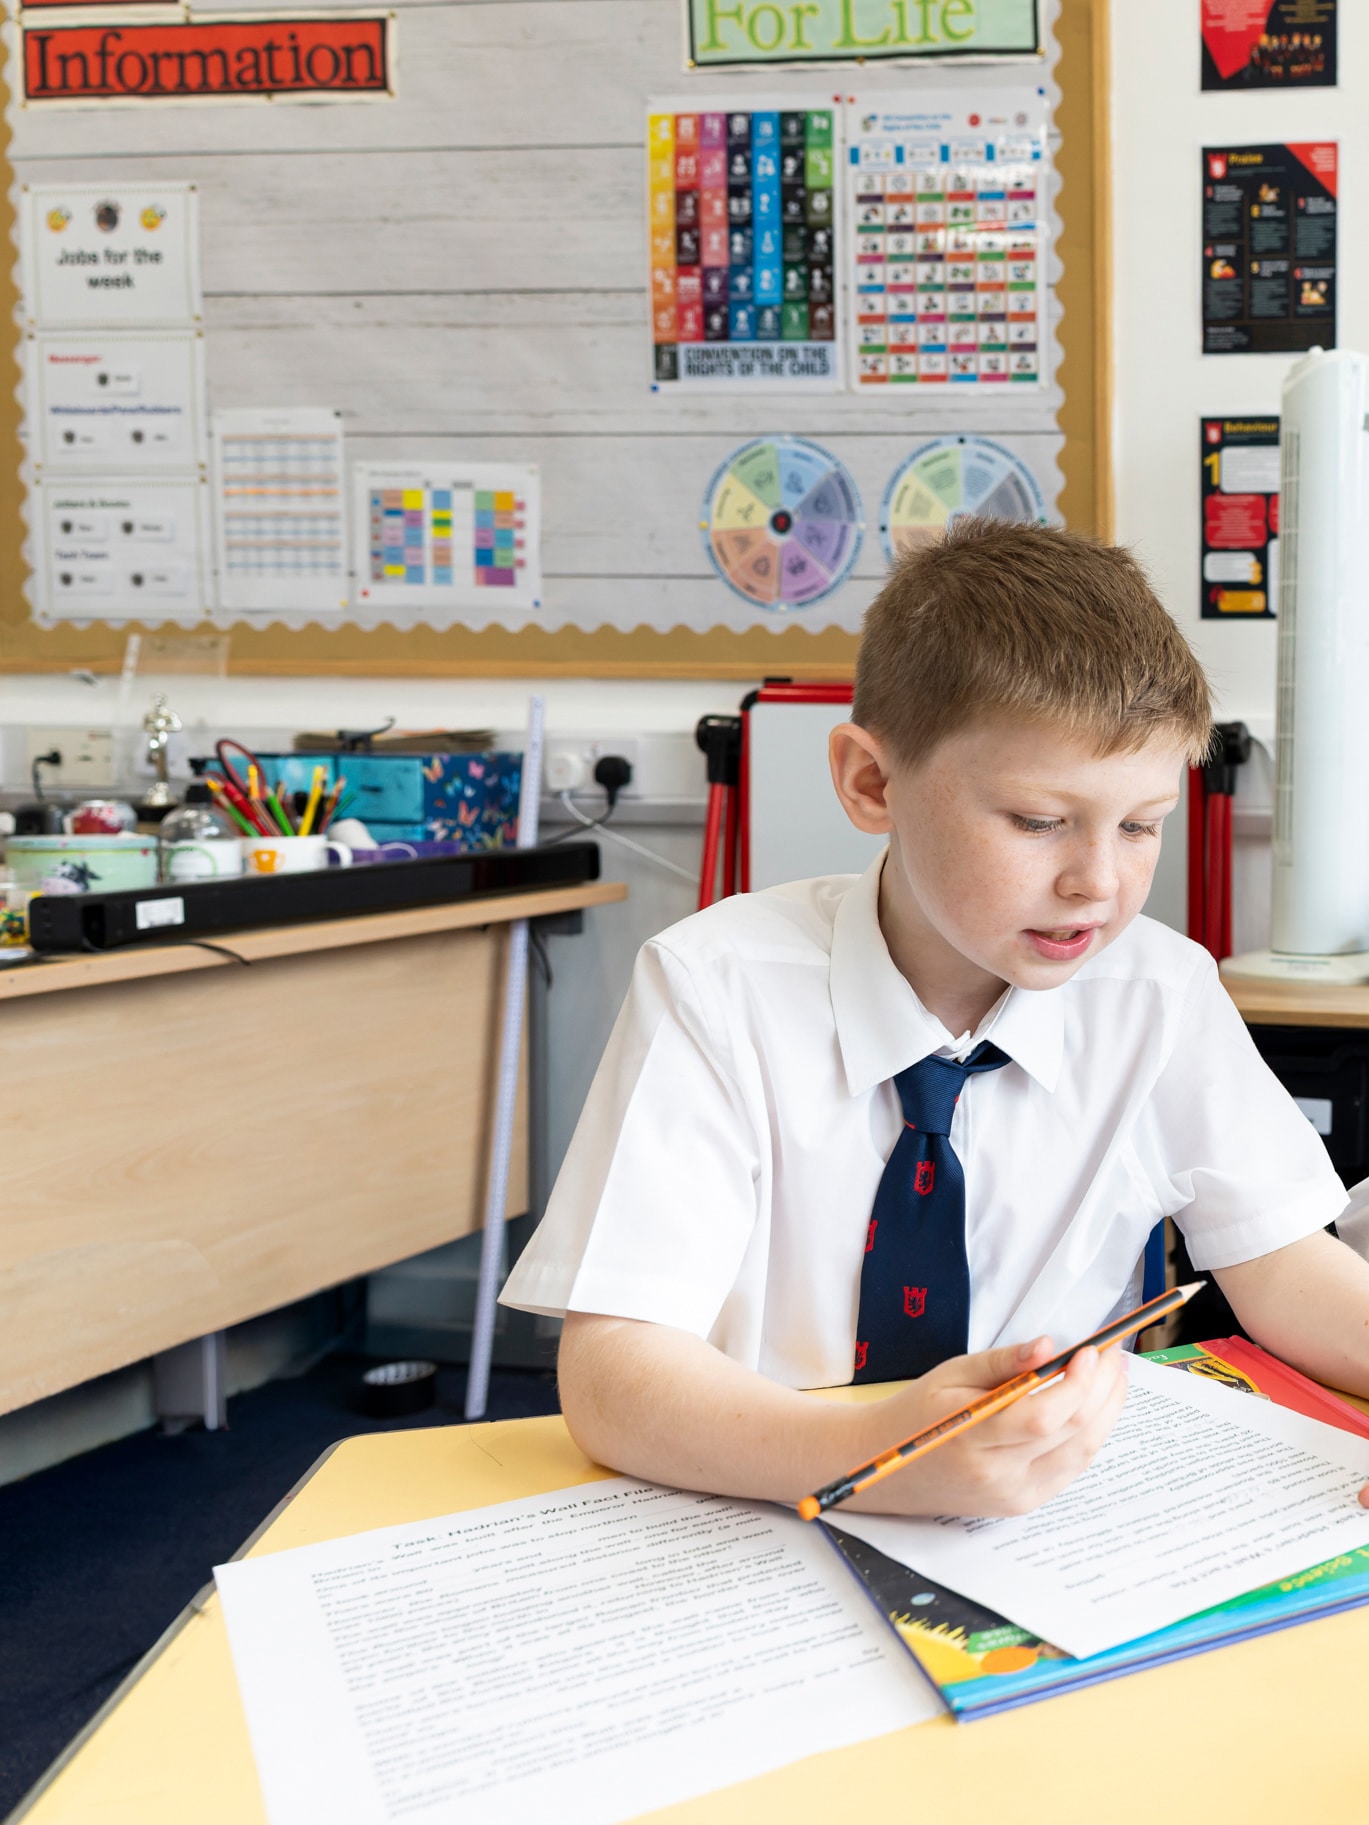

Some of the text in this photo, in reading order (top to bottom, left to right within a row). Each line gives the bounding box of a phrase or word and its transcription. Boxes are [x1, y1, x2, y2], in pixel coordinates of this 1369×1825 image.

[701, 0, 975, 50] For Life
[32, 32, 382, 92] Information
[57, 247, 162, 266] Jobs for the
[87, 272, 134, 289] week
[687, 345, 828, 361] CONVENTION ON THE
[687, 361, 830, 377] RIGHTS OF THE CHILD
[1204, 451, 1220, 486] 1
[447, 1513, 537, 1537] Hadrian's
[539, 1503, 578, 1516] Wall
[581, 1494, 621, 1507] Fact
[623, 1486, 654, 1498] File
[1280, 1555, 1353, 1592] Science
